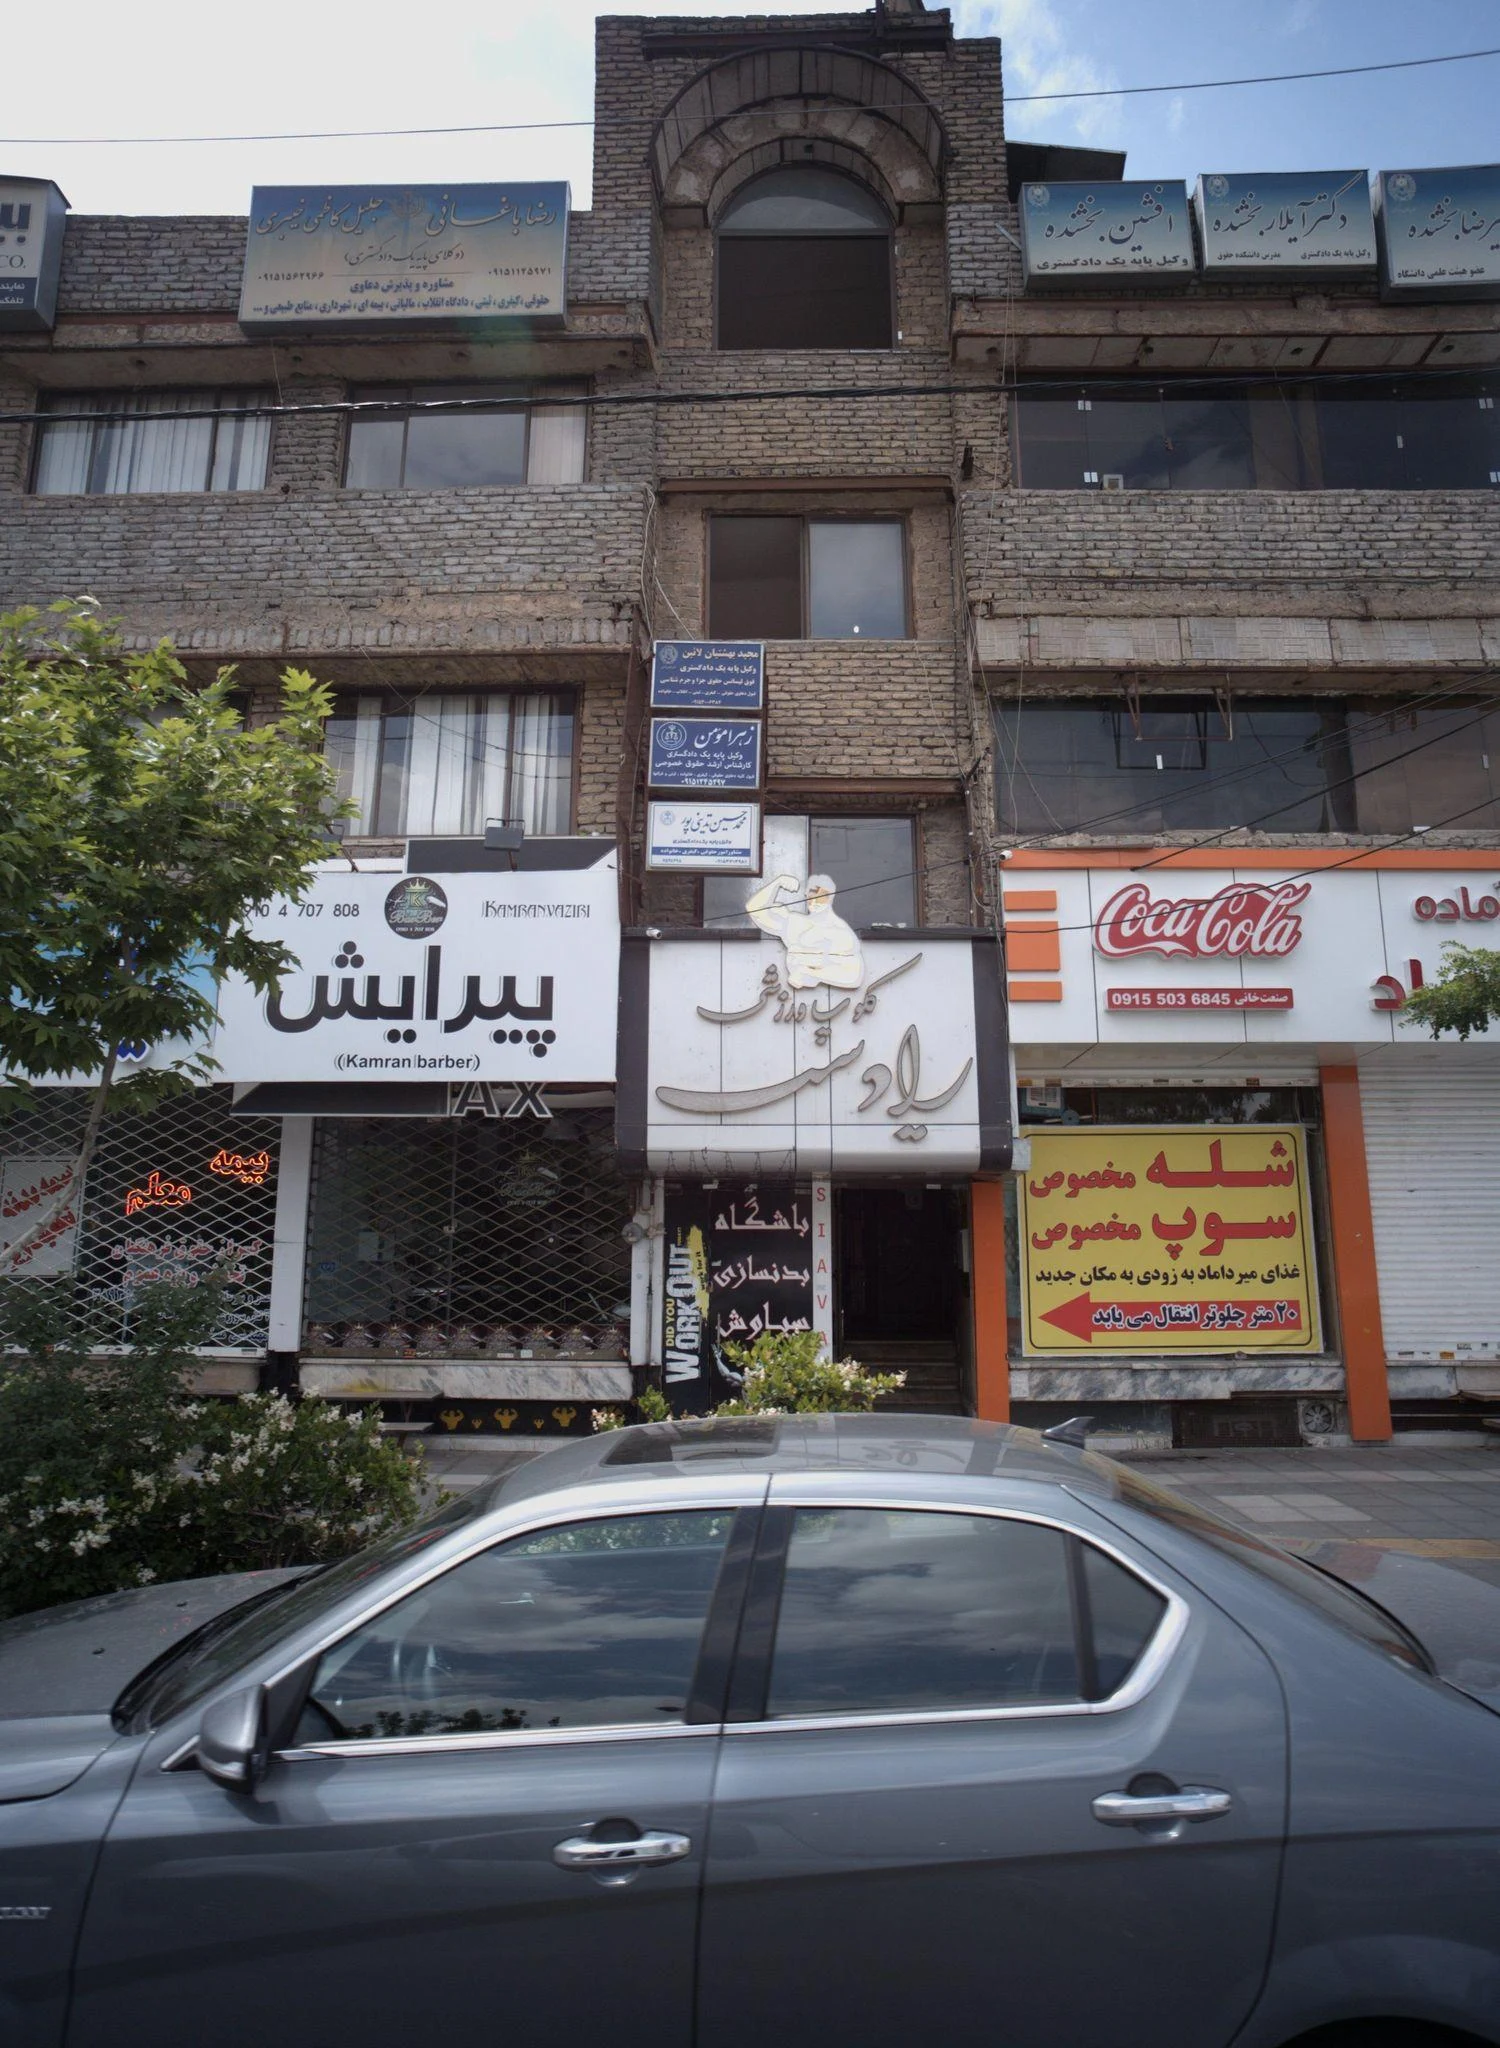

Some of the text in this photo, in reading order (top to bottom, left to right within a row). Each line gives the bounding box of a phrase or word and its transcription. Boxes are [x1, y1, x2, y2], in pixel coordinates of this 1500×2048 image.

[303, 195, 351, 233] کاظمی
[525, 200, 557, 226] رضا
[1212, 192, 1264, 236] بخشنده
[1302, 172, 1364, 238] دکتر
[341, 197, 384, 235] جلیل
[1045, 186, 1173, 252] افشین بخشنده
[1408, 196, 1459, 240] بخشنده
[1036, 255, 1189, 270] وکیل پایه یک دادگستری
[1355, 249, 1371, 259] وکیل
[1398, 269, 1425, 279] دانشگاه
[1427, 267, 1446, 280] علمی
[350, 280, 380, 293] دعاوی
[423, 278, 455, 292] مشاوره
[679, 664, 757, 675] وکیل پایه یک دادگستری
[727, 726, 755, 747] زهرا
[654, 760, 752, 770] کارشناس ارشد حقوق خصوصی
[666, 749, 743, 761] وکیل پایه یک دادگستری
[279, 903, 287, 918] 4
[298, 903, 324, 918] 707
[333, 903, 360, 918] 808
[1098, 885, 1310, 957] Coca-Cola
[264, 940, 556, 1058] پیرایش
[1112, 992, 1231, 1006] 0915 503 6845
[210, 1150, 269, 1184] بیمه
[1029, 1139, 1296, 1198] شله مخصوص
[713, 1196, 811, 1238] باشگاه
[1031, 1206, 1297, 1261] سوپ مخصوص
[712, 1255, 811, 1290] بدنسازی
[1035, 1267, 1076, 1286] جدید
[1079, 1266, 1117, 1286] مکان
[1119, 1268, 1134, 1283] به
[1136, 1268, 1178, 1286] زودی
[1180, 1267, 1194, 1282] به
[1260, 1264, 1300, 1284] غذای
[665, 1298, 675, 1347] DID YOU
[1093, 1302, 1298, 1330] ۲۰ متر جلوتر انتقال می یابد
